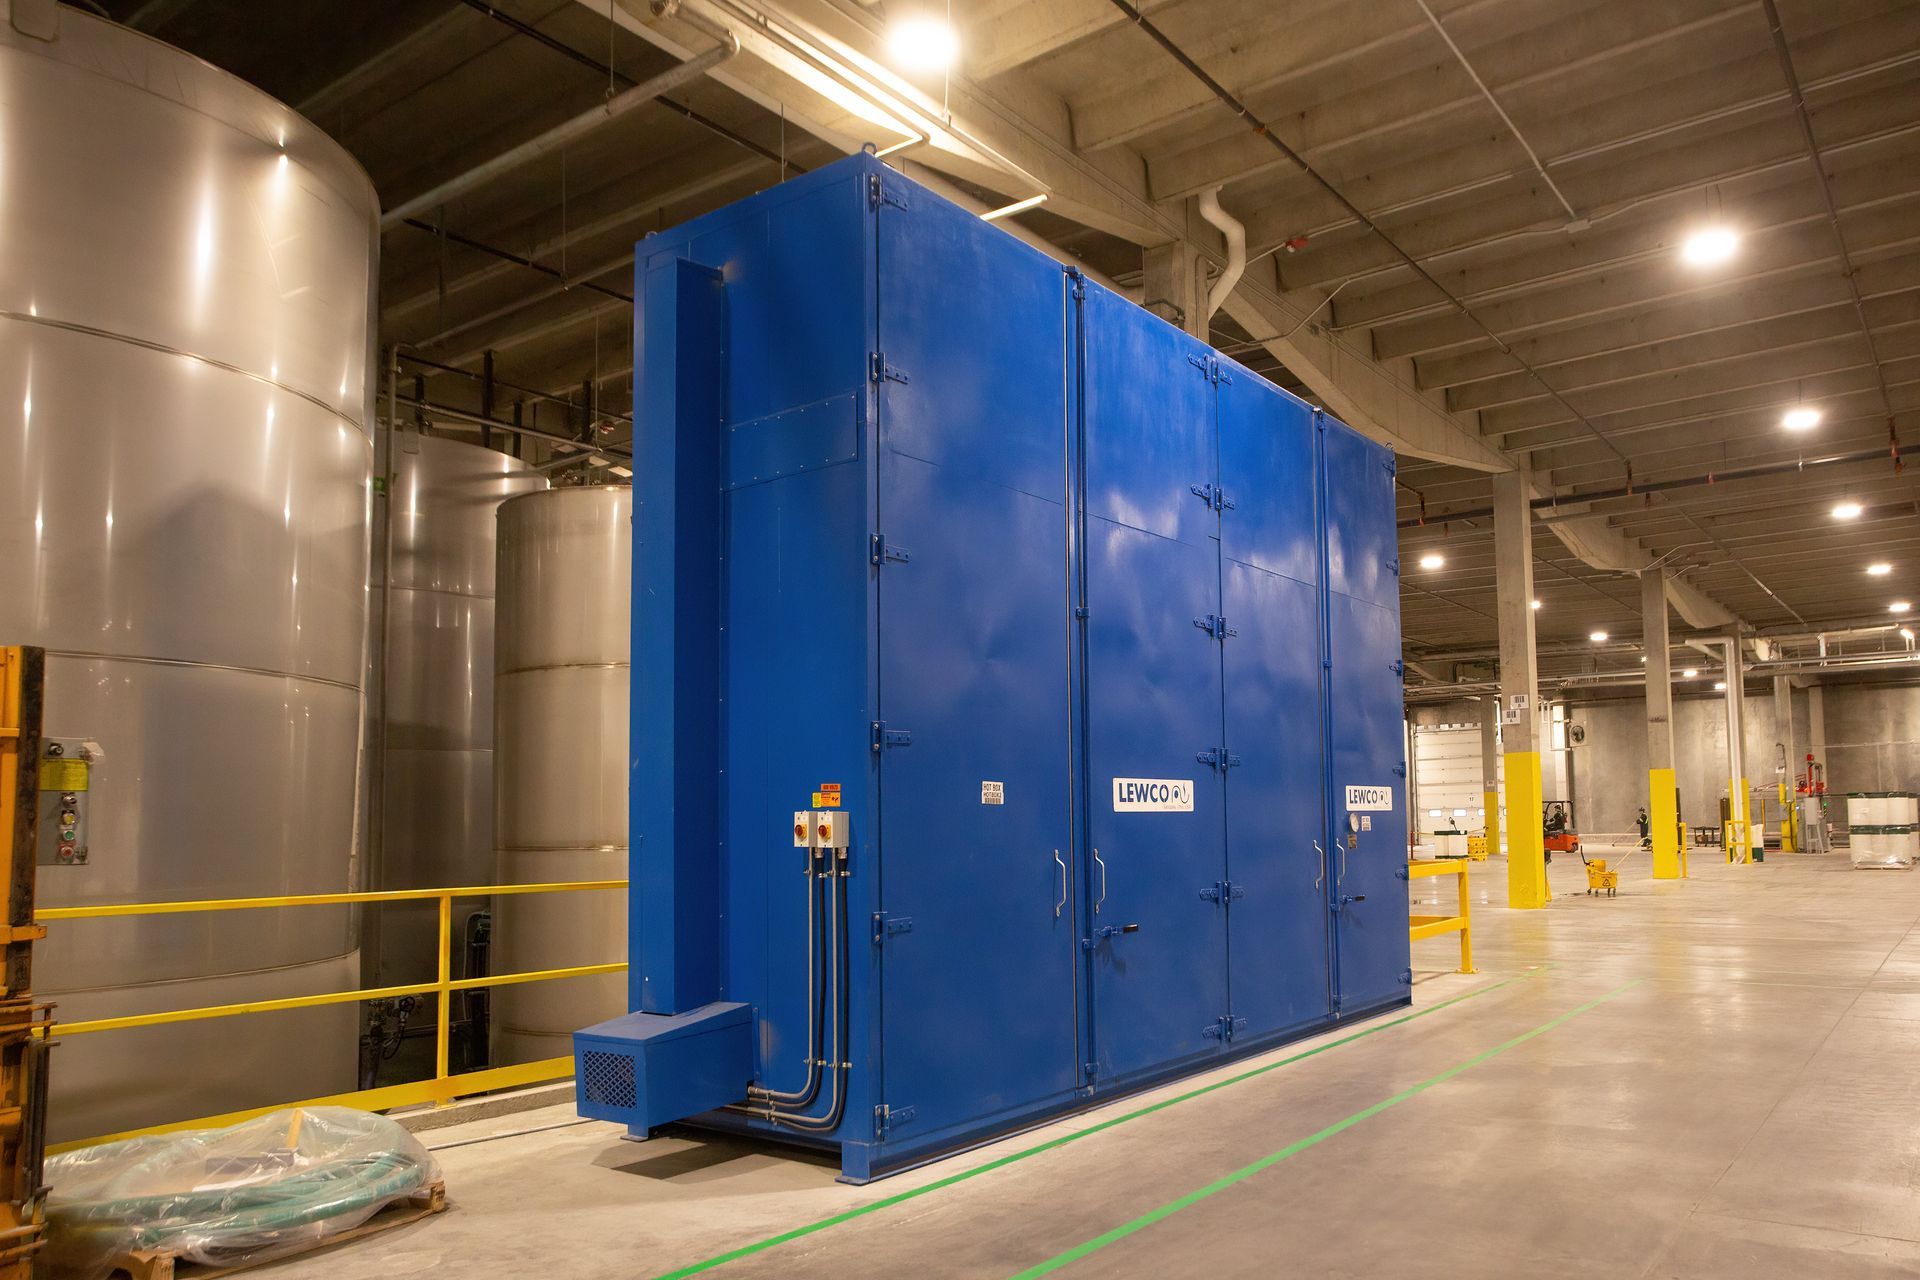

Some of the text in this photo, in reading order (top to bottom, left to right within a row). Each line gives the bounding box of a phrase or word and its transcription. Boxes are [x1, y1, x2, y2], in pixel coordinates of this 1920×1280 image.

[984, 784, 1001, 792] HOT BOX
[1118, 783, 1169, 803] LEWCO
[1349, 789, 1377, 804] LEWCO
